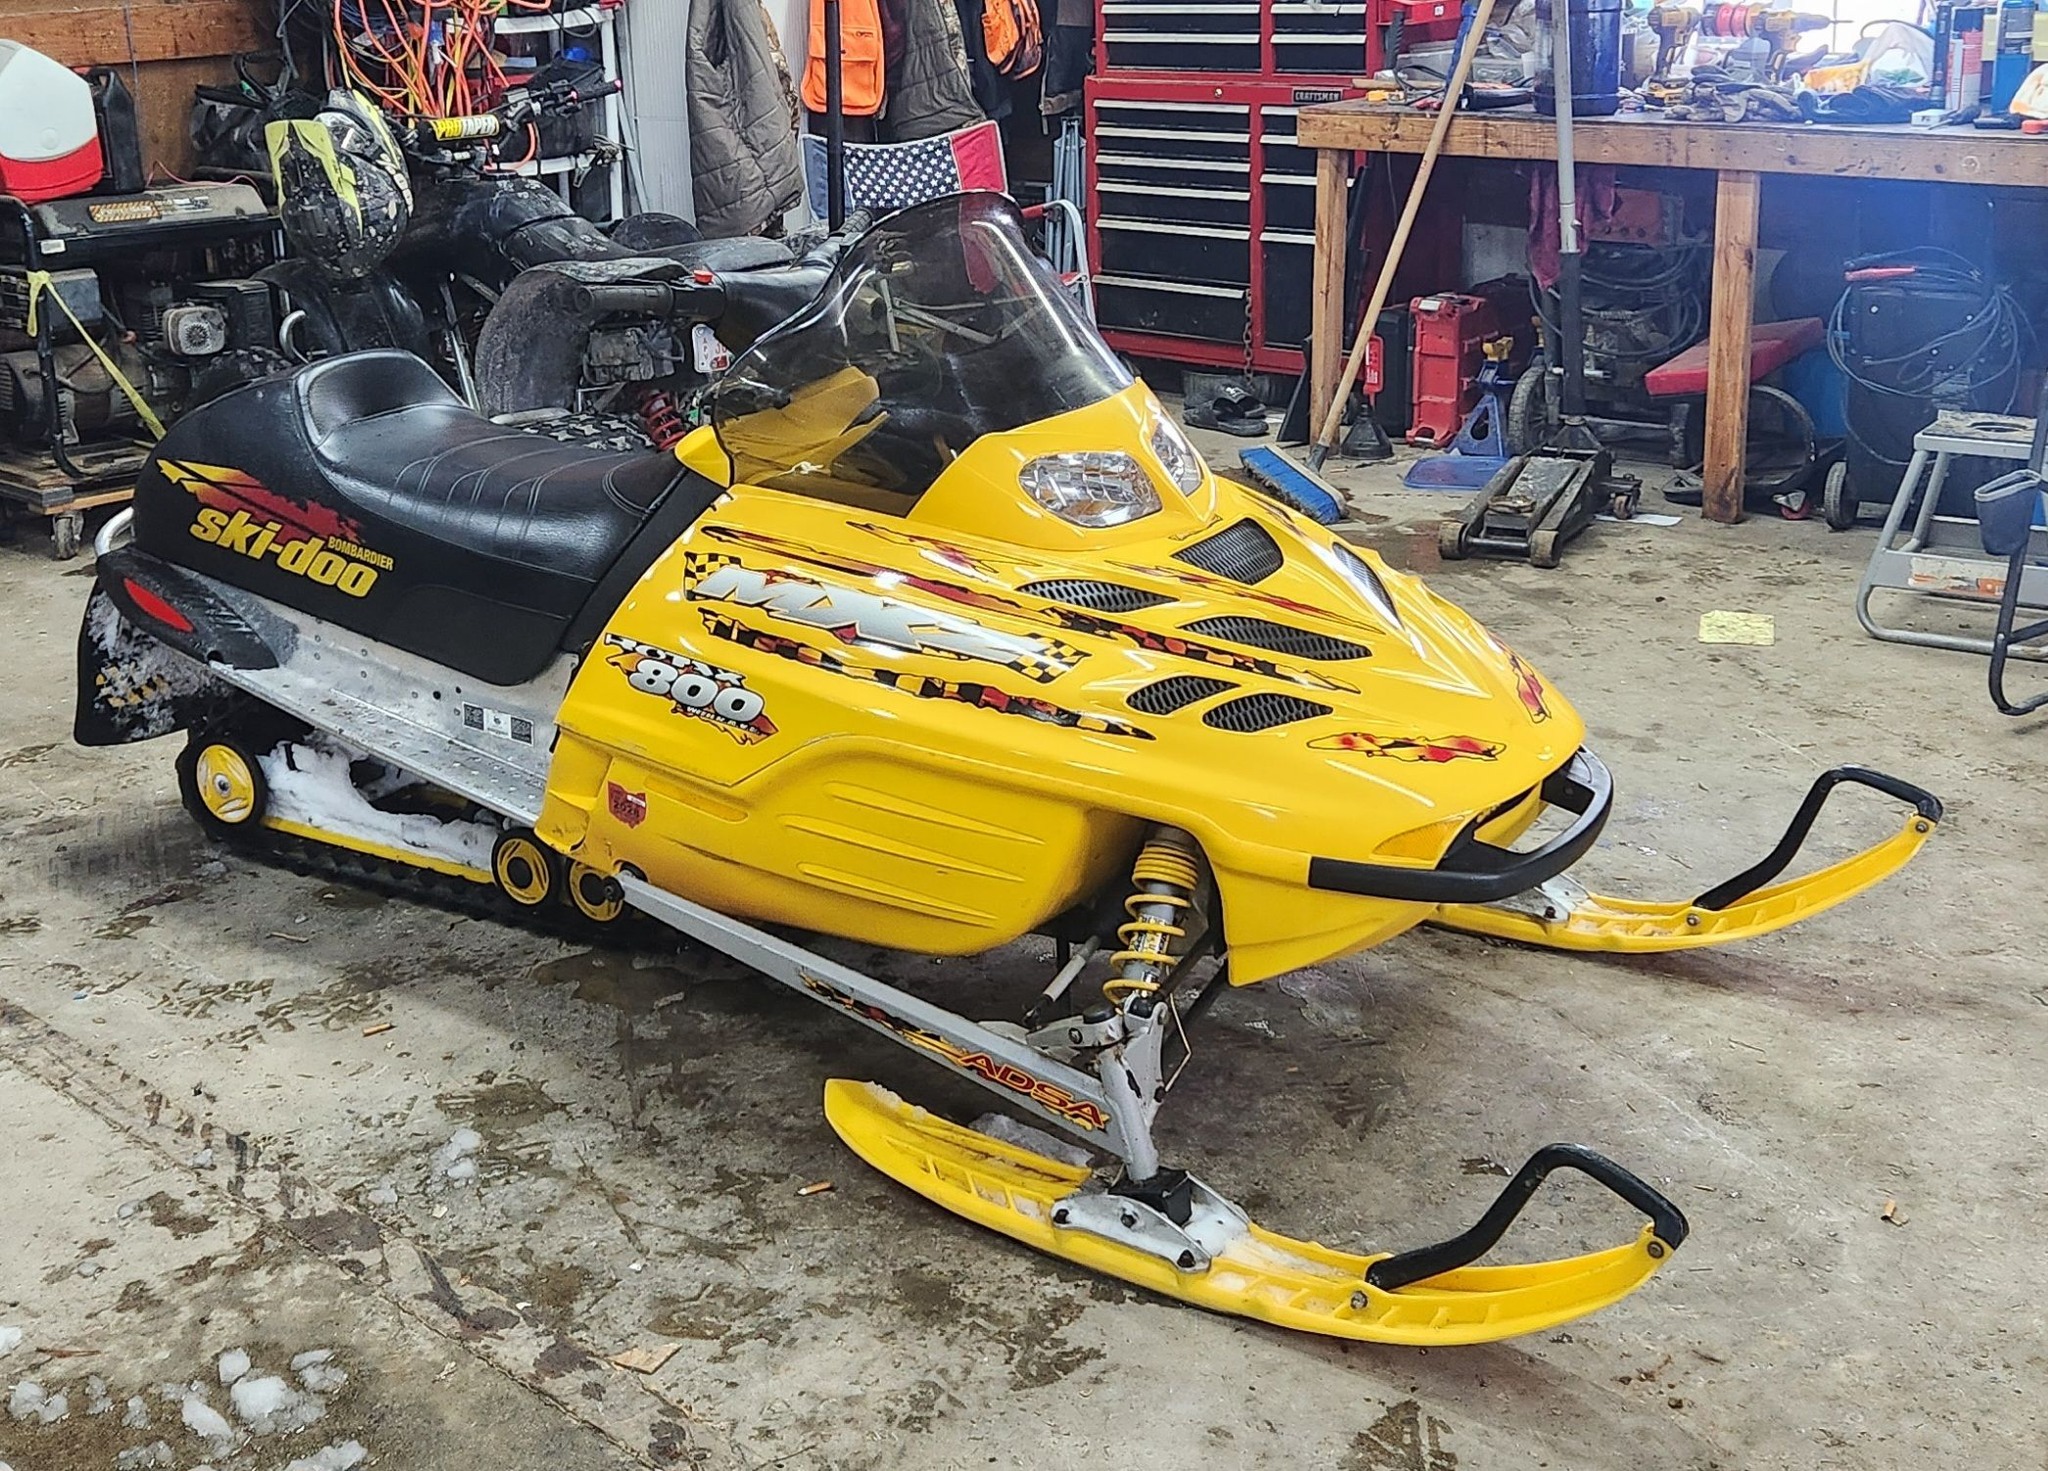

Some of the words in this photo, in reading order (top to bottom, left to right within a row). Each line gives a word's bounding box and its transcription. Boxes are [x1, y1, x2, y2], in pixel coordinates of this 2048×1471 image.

[1295, 91, 1340, 101] CRAFTSMAN
[327, 536, 394, 571] BOMBARDIER
[606, 633, 745, 687] ROTAX
[629, 658, 765, 722] 800
[958, 1052, 1105, 1130] ADSA
